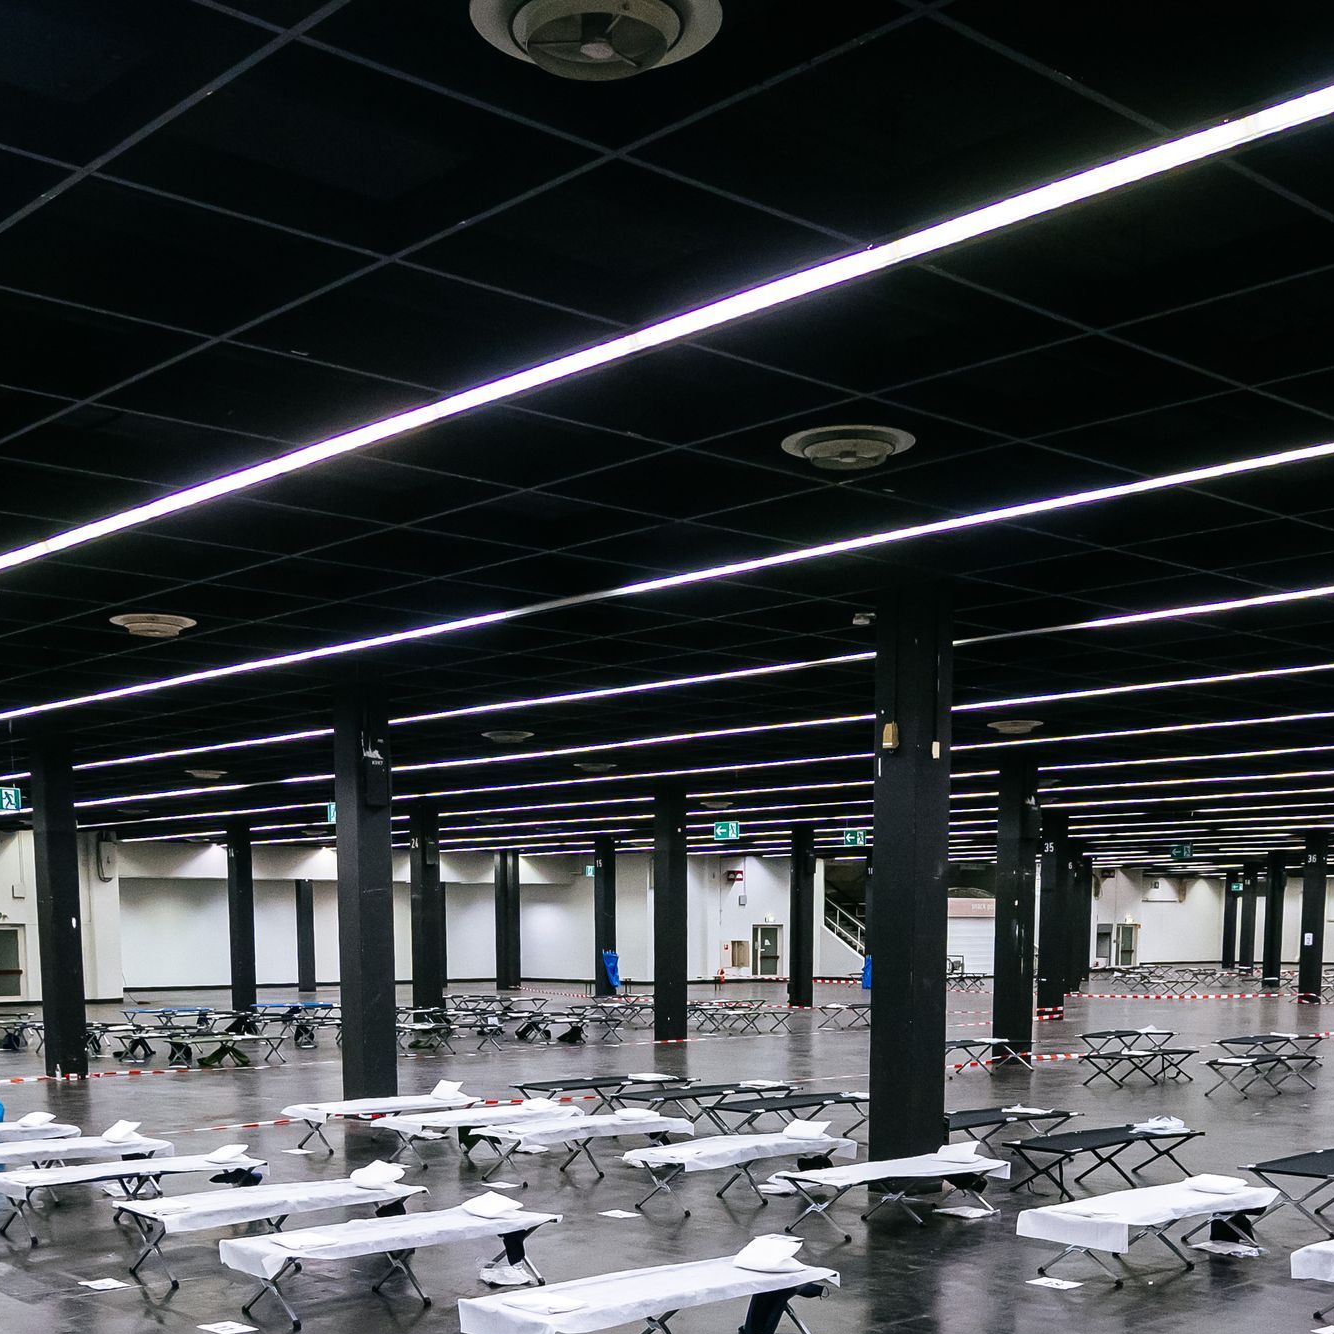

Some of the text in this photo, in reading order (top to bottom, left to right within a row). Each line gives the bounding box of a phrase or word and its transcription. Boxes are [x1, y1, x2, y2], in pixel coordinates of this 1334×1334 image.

[410, 837, 419, 849] 24
[1043, 842, 1055, 853] 35
[1307, 854, 1317, 863] 36
[1068, 861, 1073, 870] 6
